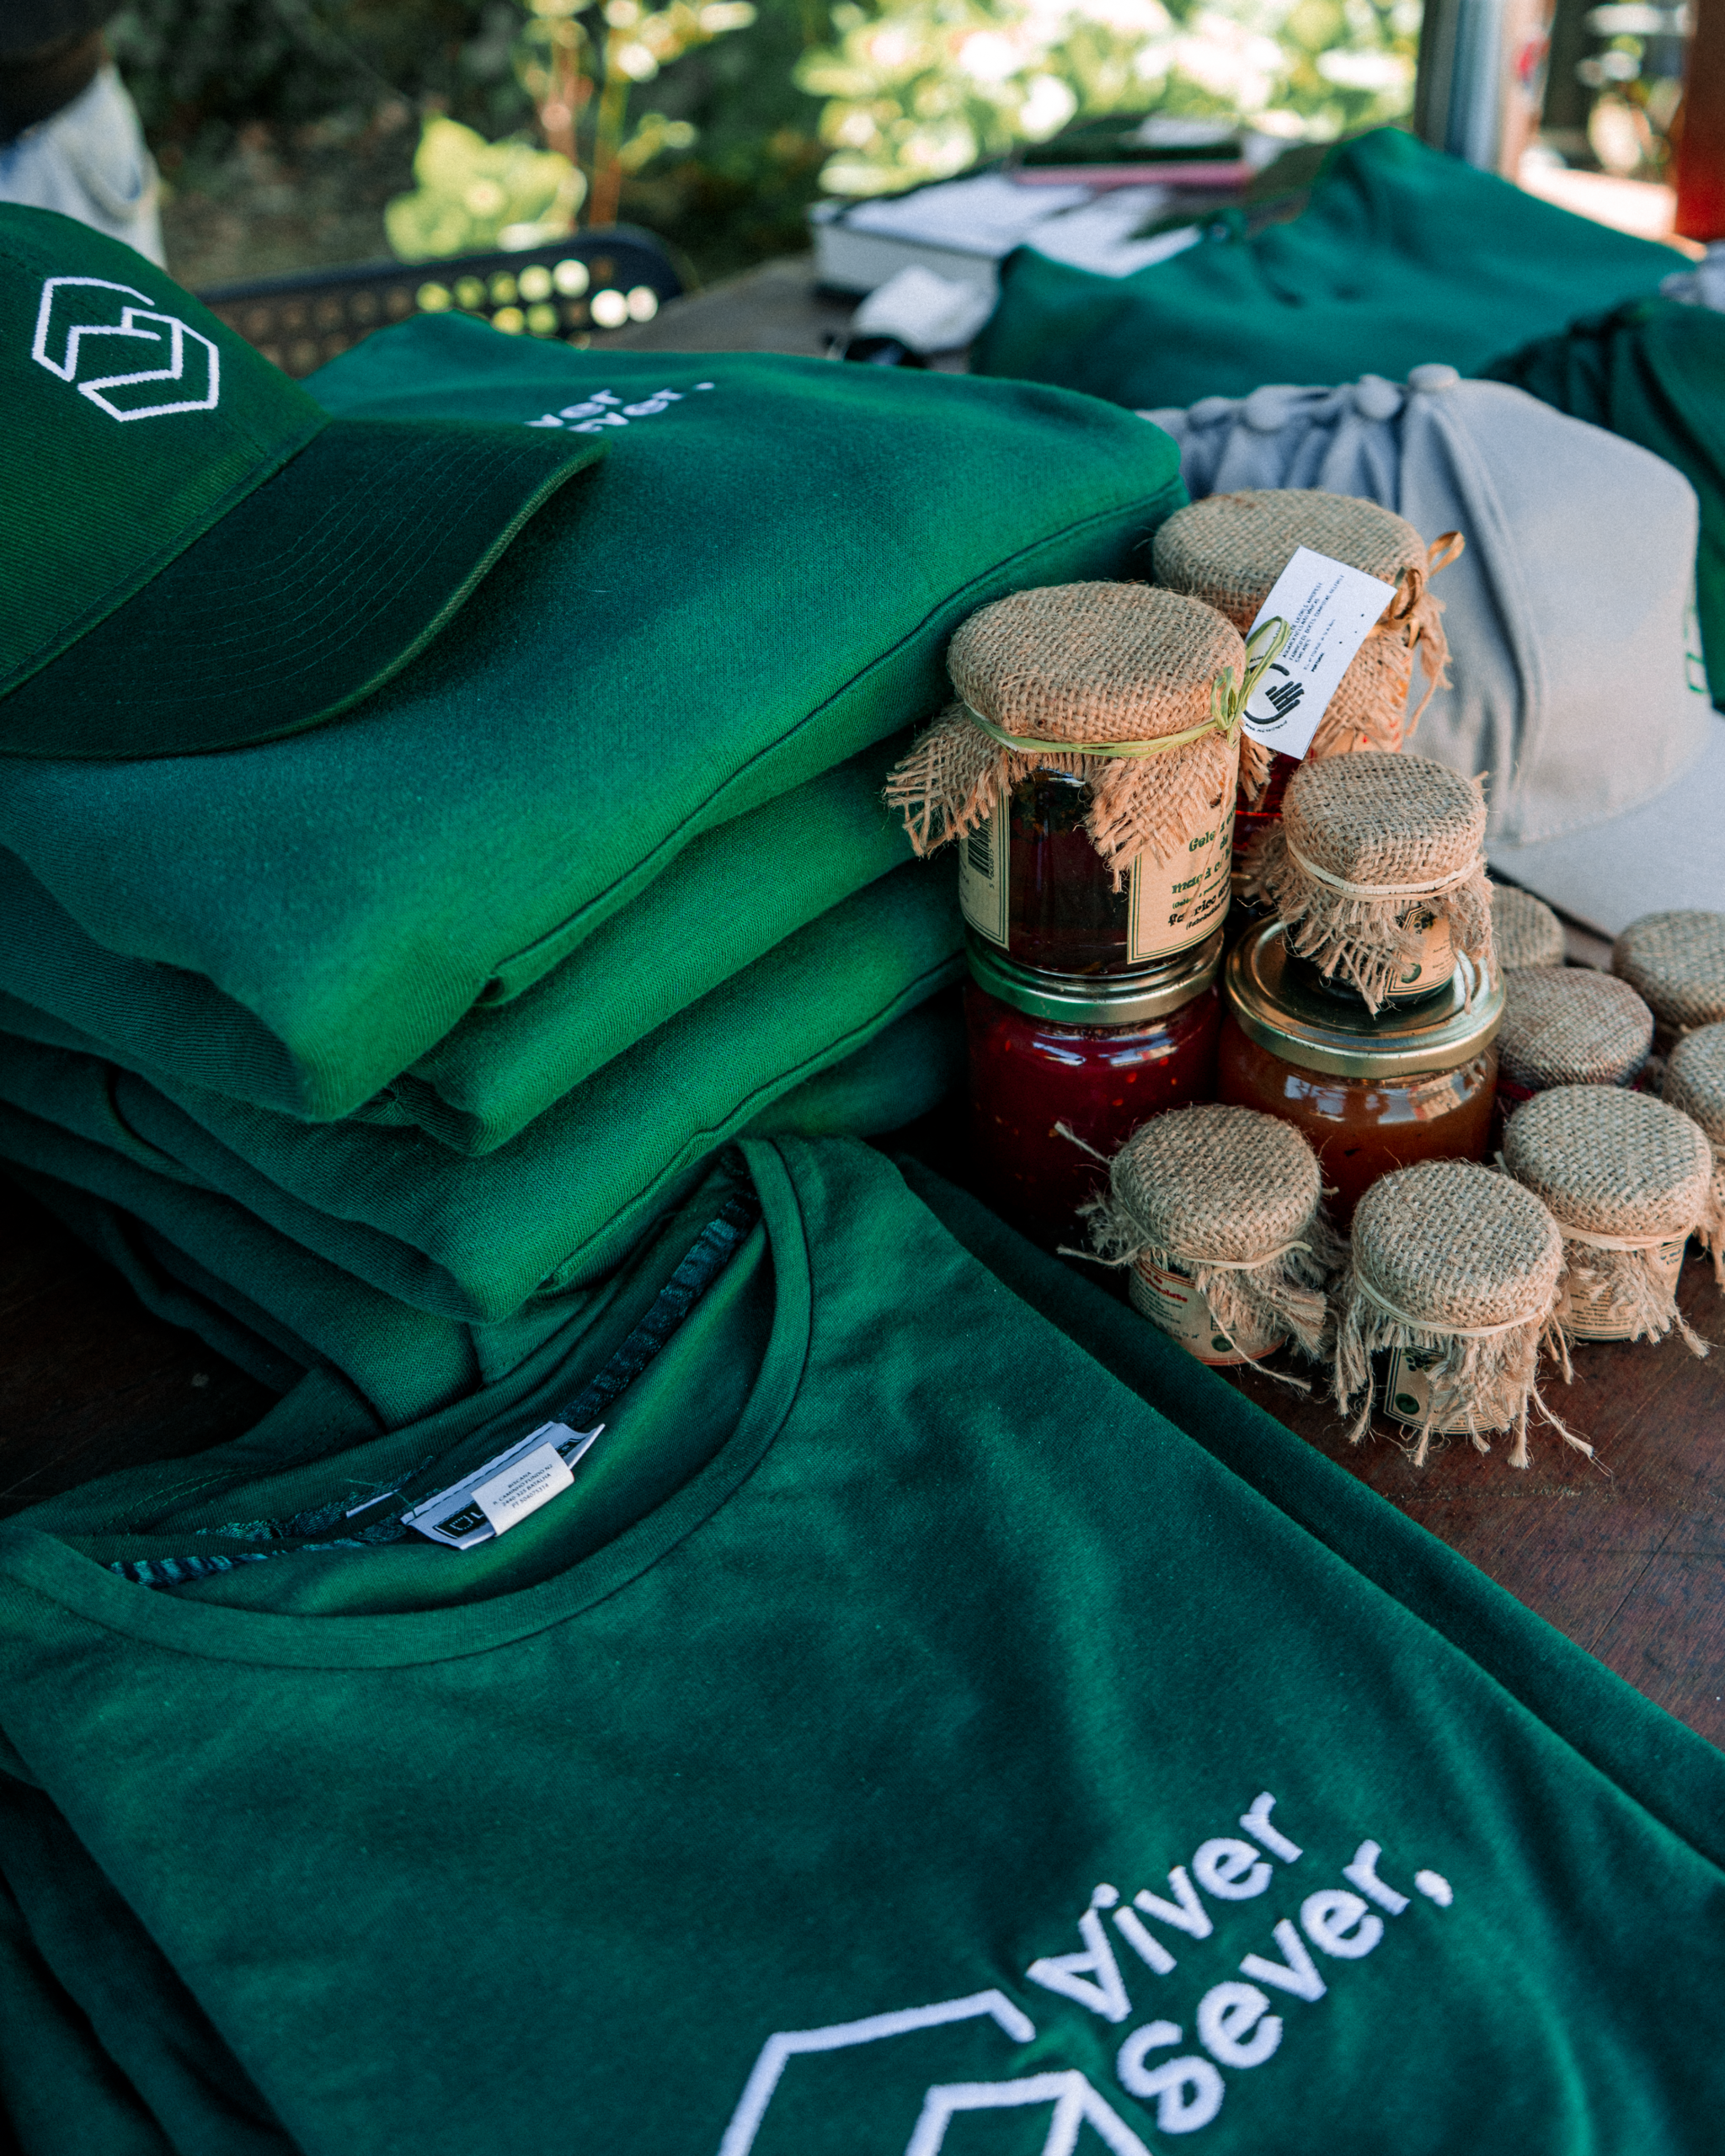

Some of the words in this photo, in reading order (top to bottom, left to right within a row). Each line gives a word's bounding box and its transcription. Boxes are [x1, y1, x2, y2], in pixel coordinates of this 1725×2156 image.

[524, 389, 622, 427] ver
[499, 1482, 526, 1502] CAMINHO
[525, 1469, 545, 1484] FUNDO
[526, 1473, 552, 1491] BATALHA
